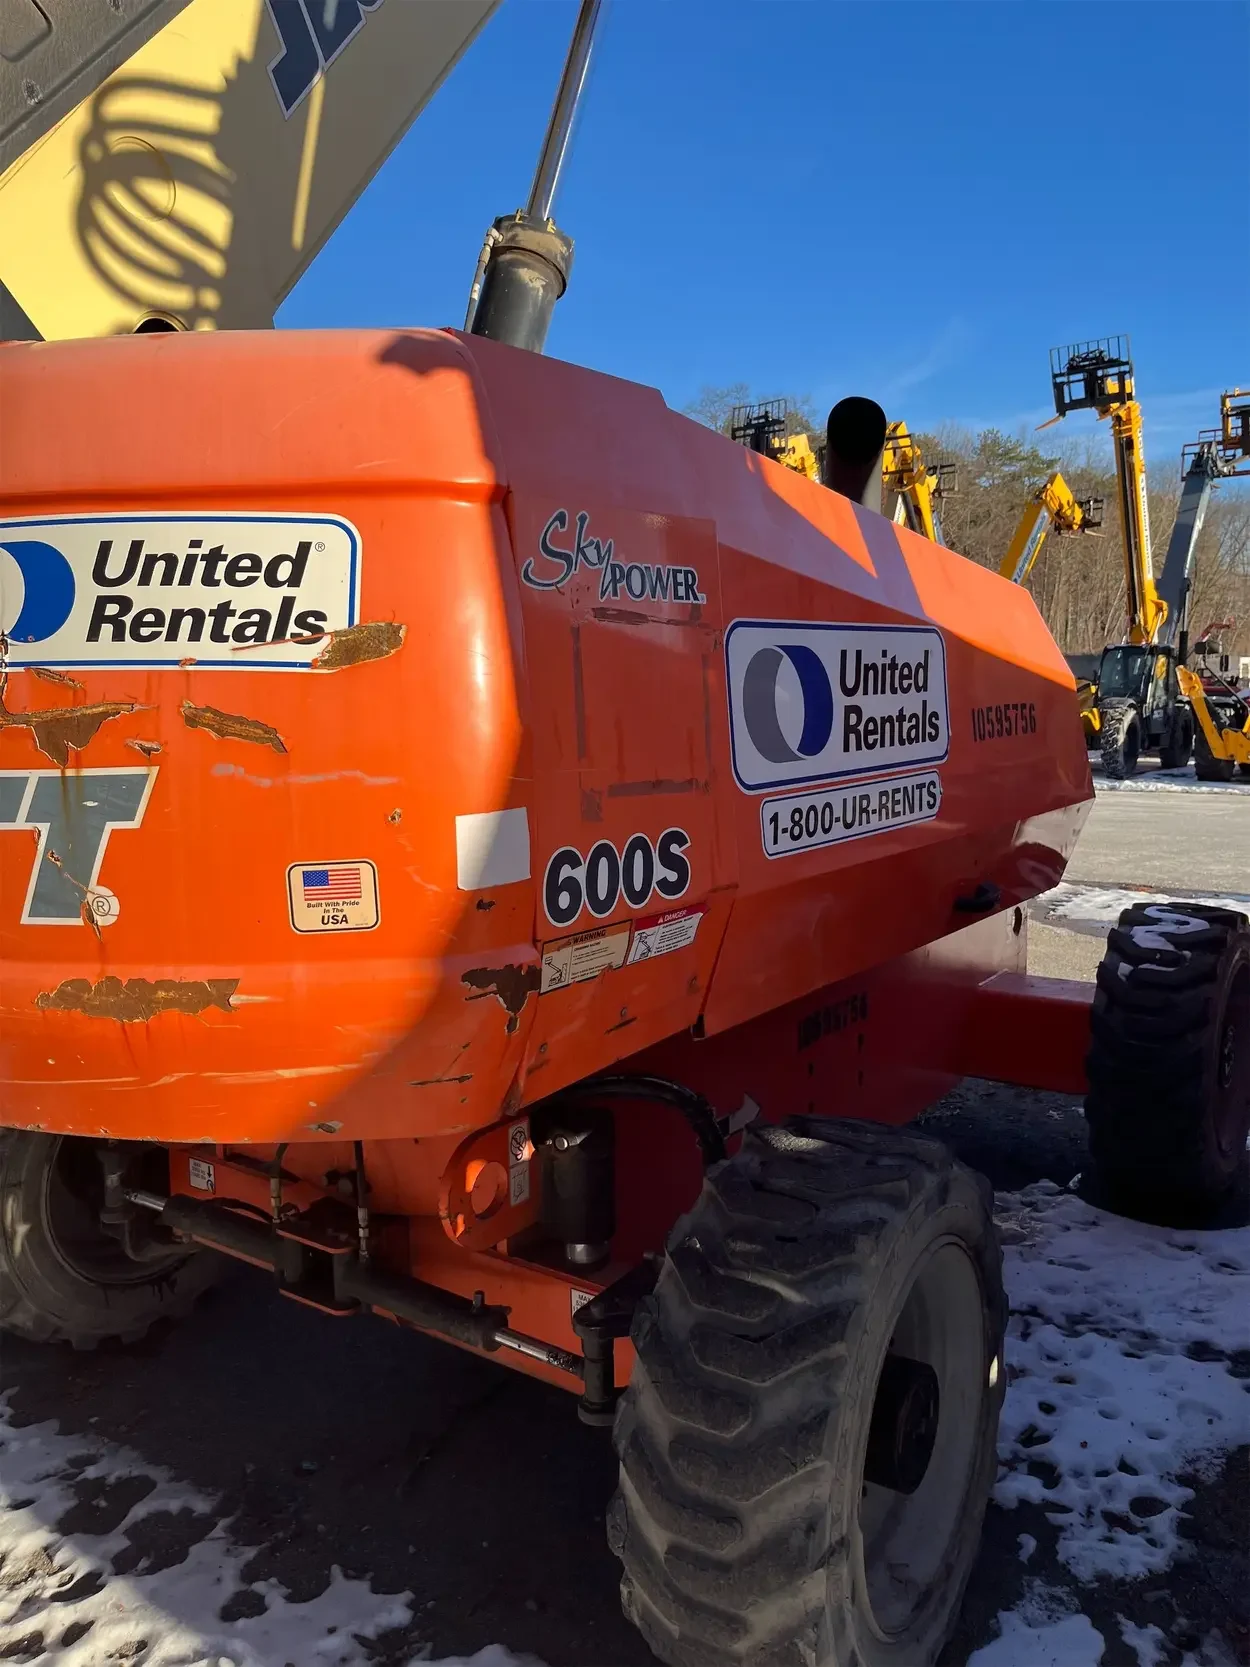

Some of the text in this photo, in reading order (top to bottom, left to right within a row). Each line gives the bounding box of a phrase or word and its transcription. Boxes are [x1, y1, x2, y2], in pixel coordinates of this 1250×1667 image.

[92, 540, 312, 588] United
[86, 595, 328, 645] Rentals
[839, 649, 930, 698] United
[843, 700, 940, 752] Rentals
[971, 703, 1036, 742] 10595756
[769, 780, 937, 846] 1-800-UR-RENTS
[0, 767, 159, 925] T
[544, 828, 691, 926] 600S
[321, 914, 348, 925] USA
[573, 929, 606, 944] WARNING
